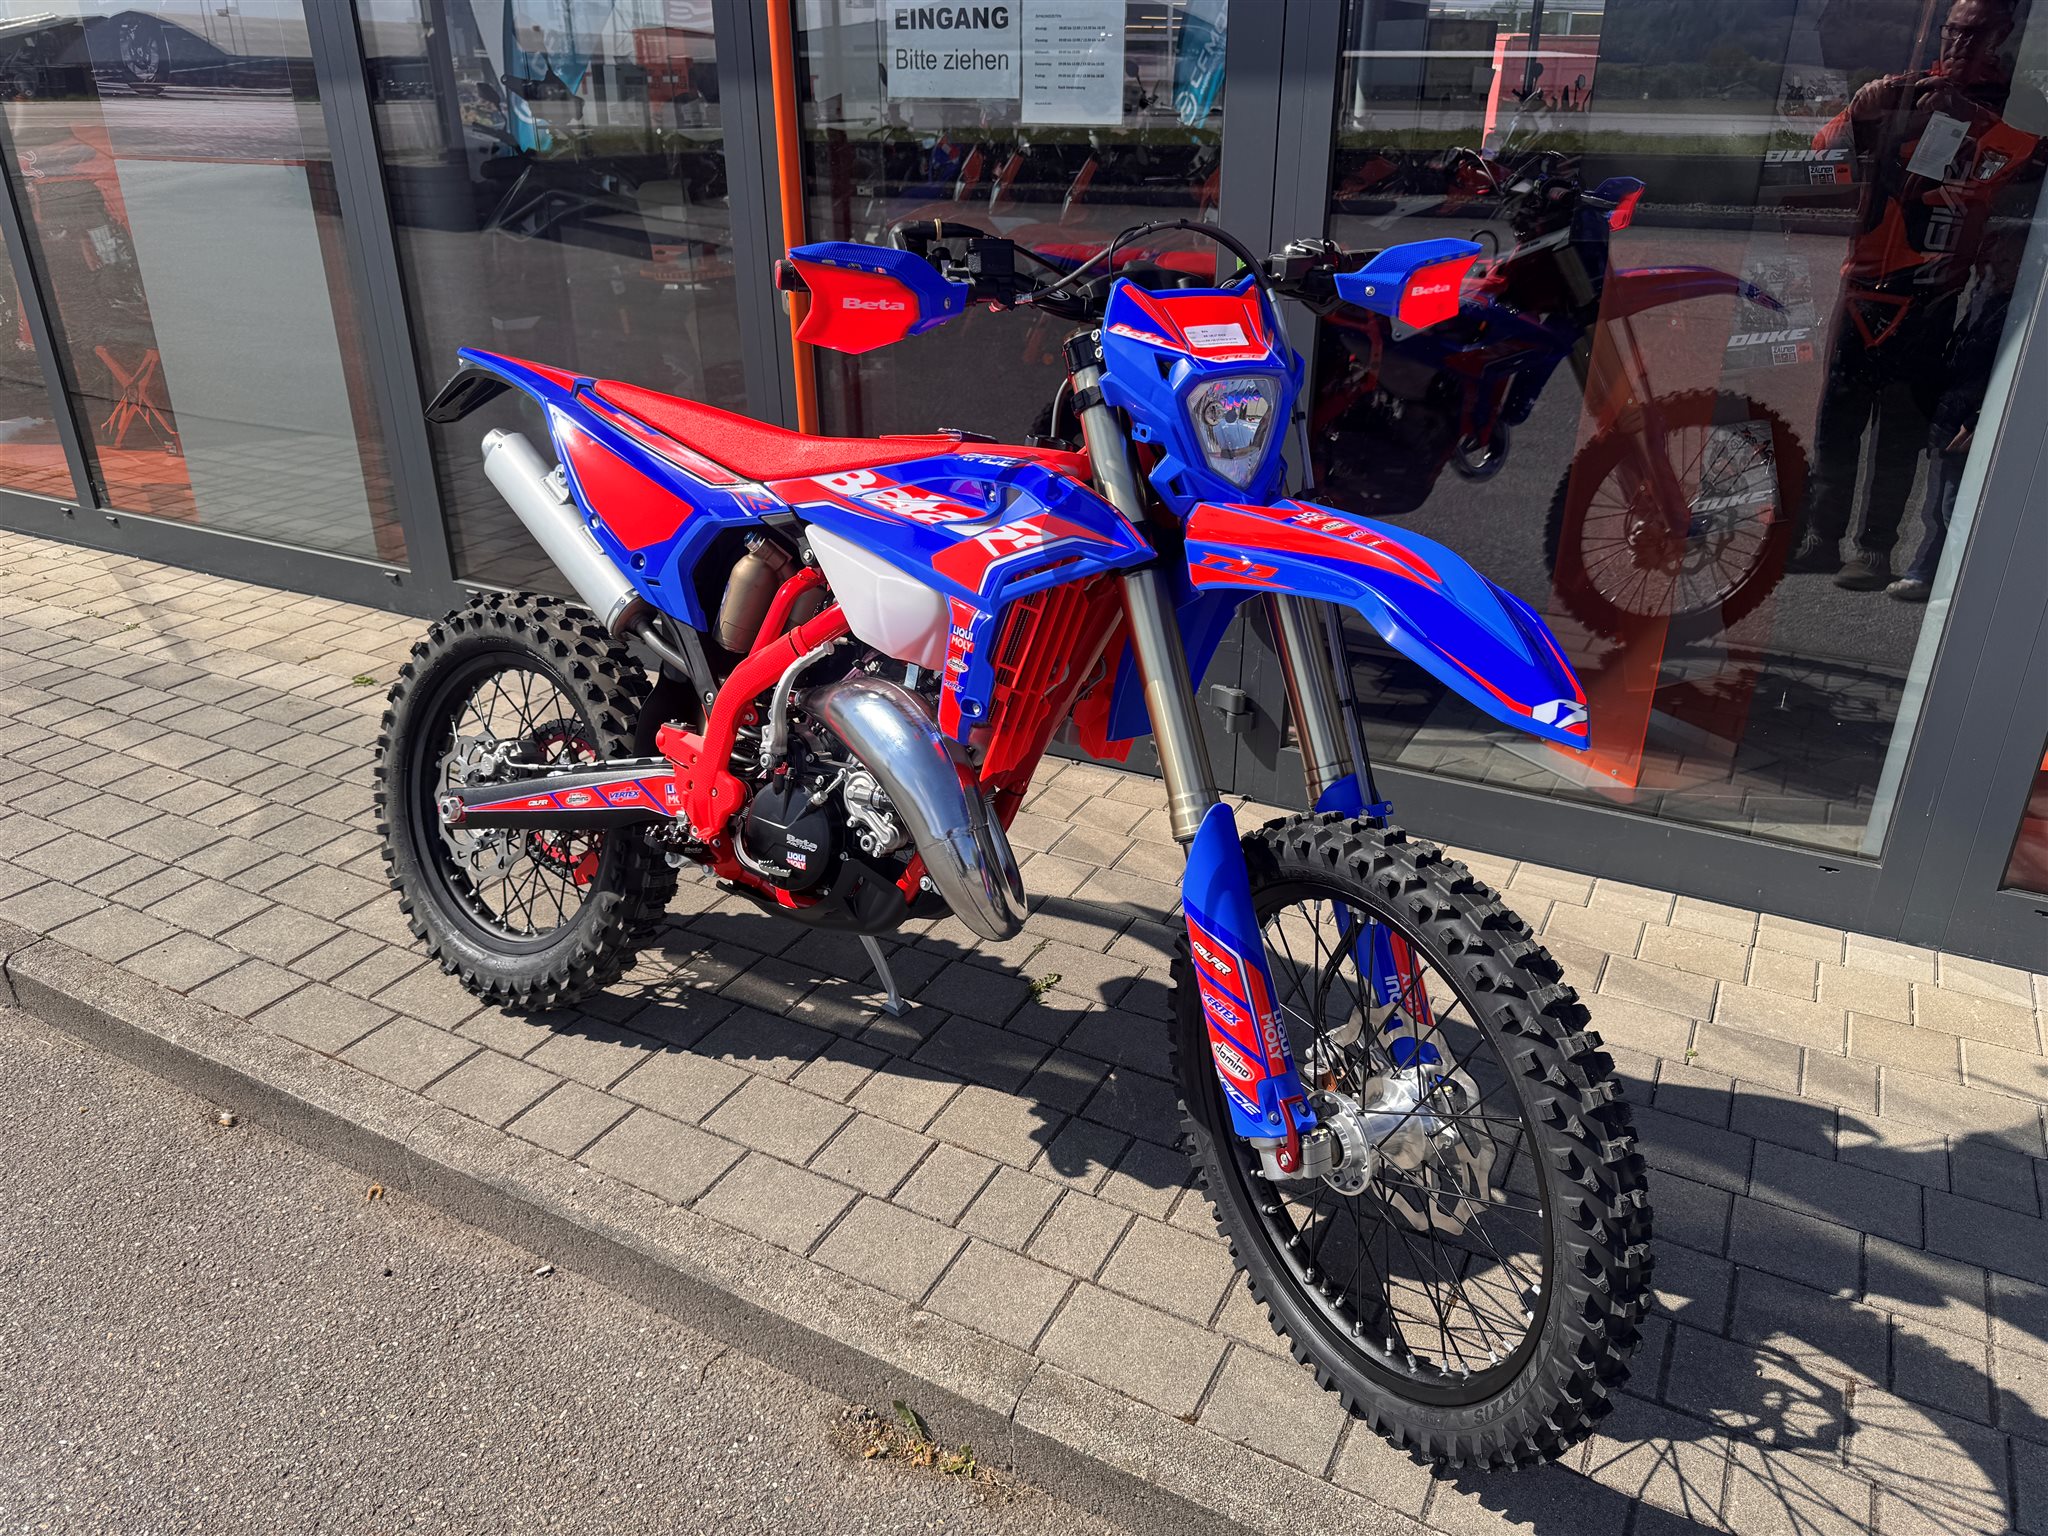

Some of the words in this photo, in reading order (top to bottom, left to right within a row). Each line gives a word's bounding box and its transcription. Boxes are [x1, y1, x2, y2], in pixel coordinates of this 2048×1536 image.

[895, 7, 1009, 30] EINGANG
[896, 49, 937, 70] Bitte
[943, 48, 1009, 70] ziehen
[1411, 284, 1451, 296] Beta
[842, 297, 905, 311] Beta
[1108, 324, 1165, 345] Beta
[1727, 328, 1811, 347] DUKE
[810, 469, 971, 526] Beta
[1690, 490, 1774, 513] DUKE
[950, 635, 973, 652] MOLY
[952, 624, 974, 642] LIQUI
[610, 789, 641, 800] VERTEX
[787, 833, 818, 850] Beta
[787, 851, 806, 862] LIQUI
[1202, 989, 1242, 1025] VERTEX
[1261, 1013, 1284, 1060] MOLY
[1273, 1010, 1291, 1057] LIQUI
[1215, 1043, 1250, 1079] domino
[1473, 1368, 1533, 1426] MAXXIS
